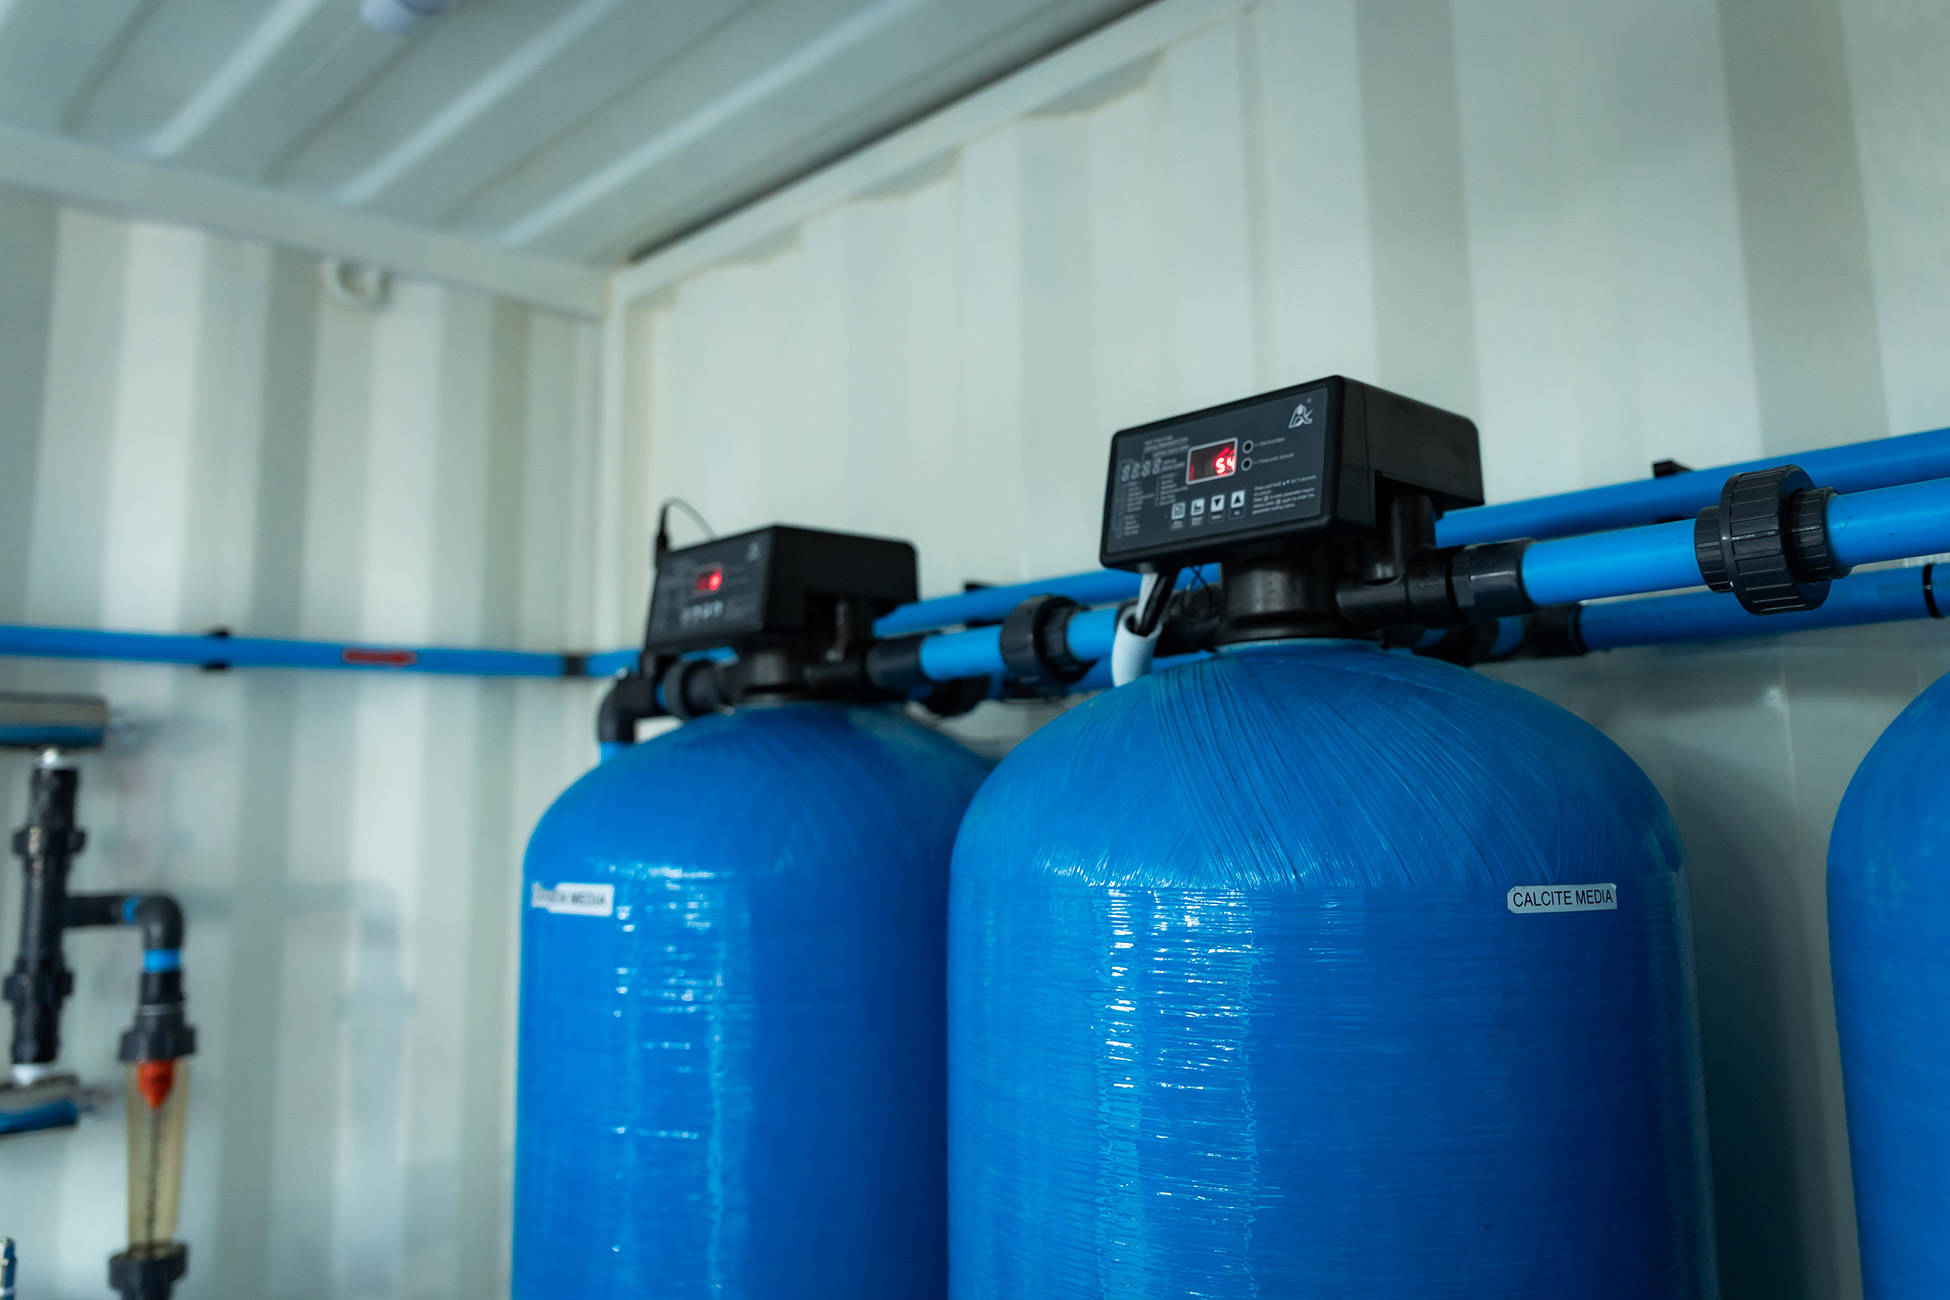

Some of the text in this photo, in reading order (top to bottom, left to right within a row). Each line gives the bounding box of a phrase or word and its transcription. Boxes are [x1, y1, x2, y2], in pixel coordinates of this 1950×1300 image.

[1215, 456, 1236, 475] 54
[1512, 888, 1614, 908] CALCITE MEDIA
